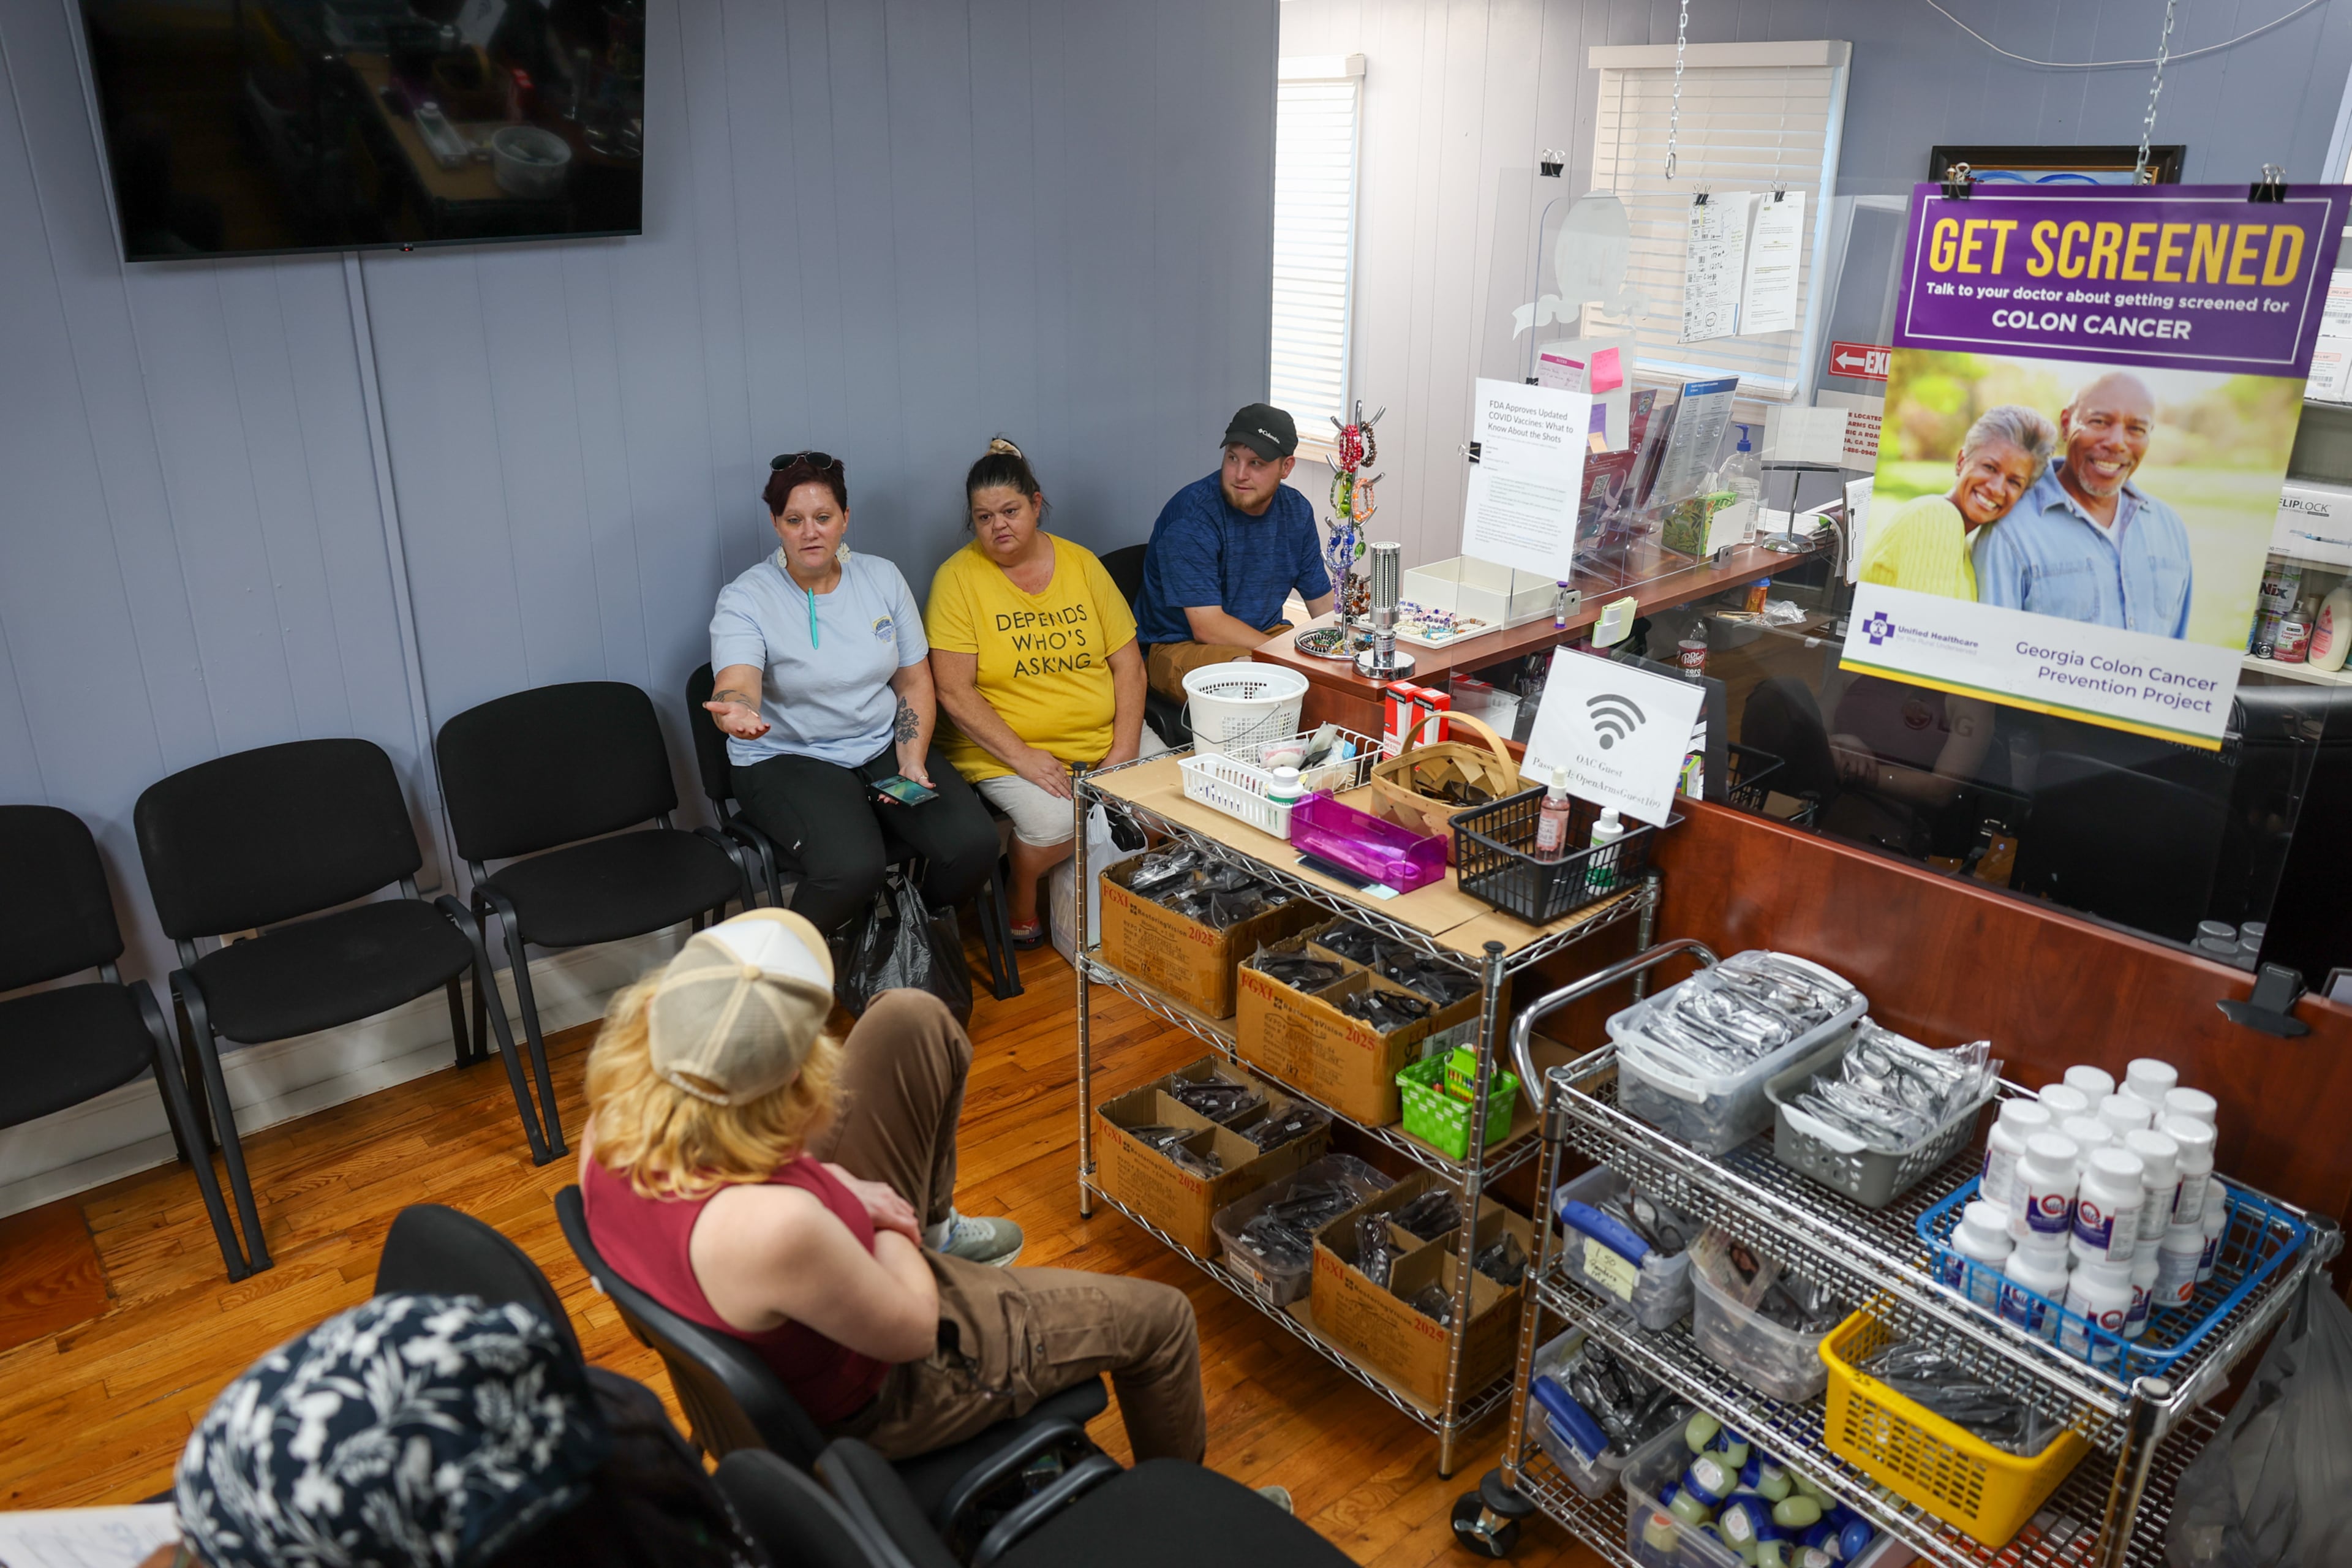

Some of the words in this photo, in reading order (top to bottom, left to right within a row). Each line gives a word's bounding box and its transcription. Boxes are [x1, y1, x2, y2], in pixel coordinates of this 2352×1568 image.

[1929, 217, 2018, 274] GET
[2026, 220, 2305, 287] SCREENED
[1926, 282, 1954, 296] Talk
[1958, 284, 1973, 297] to
[1977, 286, 2010, 302] your
[2013, 287, 2062, 302] doctor
[2065, 289, 2111, 304] about
[2114, 292, 2174, 310] getting
[2178, 295, 2259, 311] screened
[2263, 298, 2290, 313] for
[1991, 309, 2076, 333] COLON
[2082, 314, 2192, 340] CANCER
[1864, 351, 1891, 375] EXI
[1490, 400, 1504, 409] FDA
[1506, 402, 1537, 415] Approves
[1538, 409, 1568, 421] Updated
[1854, 413, 1882, 421] LOCATED
[1488, 423, 1507, 432] Know
[1508, 426, 1528, 437] About
[1529, 431, 1541, 439] the
[1542, 432, 1562, 443] Shots
[1489, 412, 1512, 423] COVID
[1513, 415, 1544, 428] Vaccines:
[1545, 421, 1564, 432] What
[1566, 425, 1574, 434] to
[1262, 430, 1280, 445] Columbia
[1843, 447, 1877, 456] -886-0940
[2260, 582, 2288, 599] Nix
[995, 604, 1088, 631] DEPENDS
[1011, 628, 1087, 652] WHO'S
[1898, 625, 1929, 638] Unified
[1931, 632, 1978, 647] Healthcare
[1683, 653, 1704, 665] Pepper
[2016, 641, 2084, 668] Georgia
[2090, 655, 2143, 677] Colon
[2148, 666, 2218, 693] Cancer
[2038, 666, 2137, 699] Prevention
[2143, 687, 2213, 714] Project
[1938, 714, 1975, 737] LG
[1576, 754, 1597, 769] OAC
[1598, 761, 1623, 778] Guest
[1532, 756, 1574, 780] Passd:
[1576, 773, 1660, 810] OpenArmsGuest109
[1103, 884, 1129, 908] FGXI
[1137, 909, 1187, 938] RestoringVision
[1188, 926, 1215, 948] 2025
[1241, 972, 1273, 1001] FGXI
[1344, 1027, 1376, 1052] 2025
[1099, 1120, 1123, 1147] FGXI
[1178, 1174, 1202, 1194] 2025
[1414, 1317, 1445, 1343] 2025
